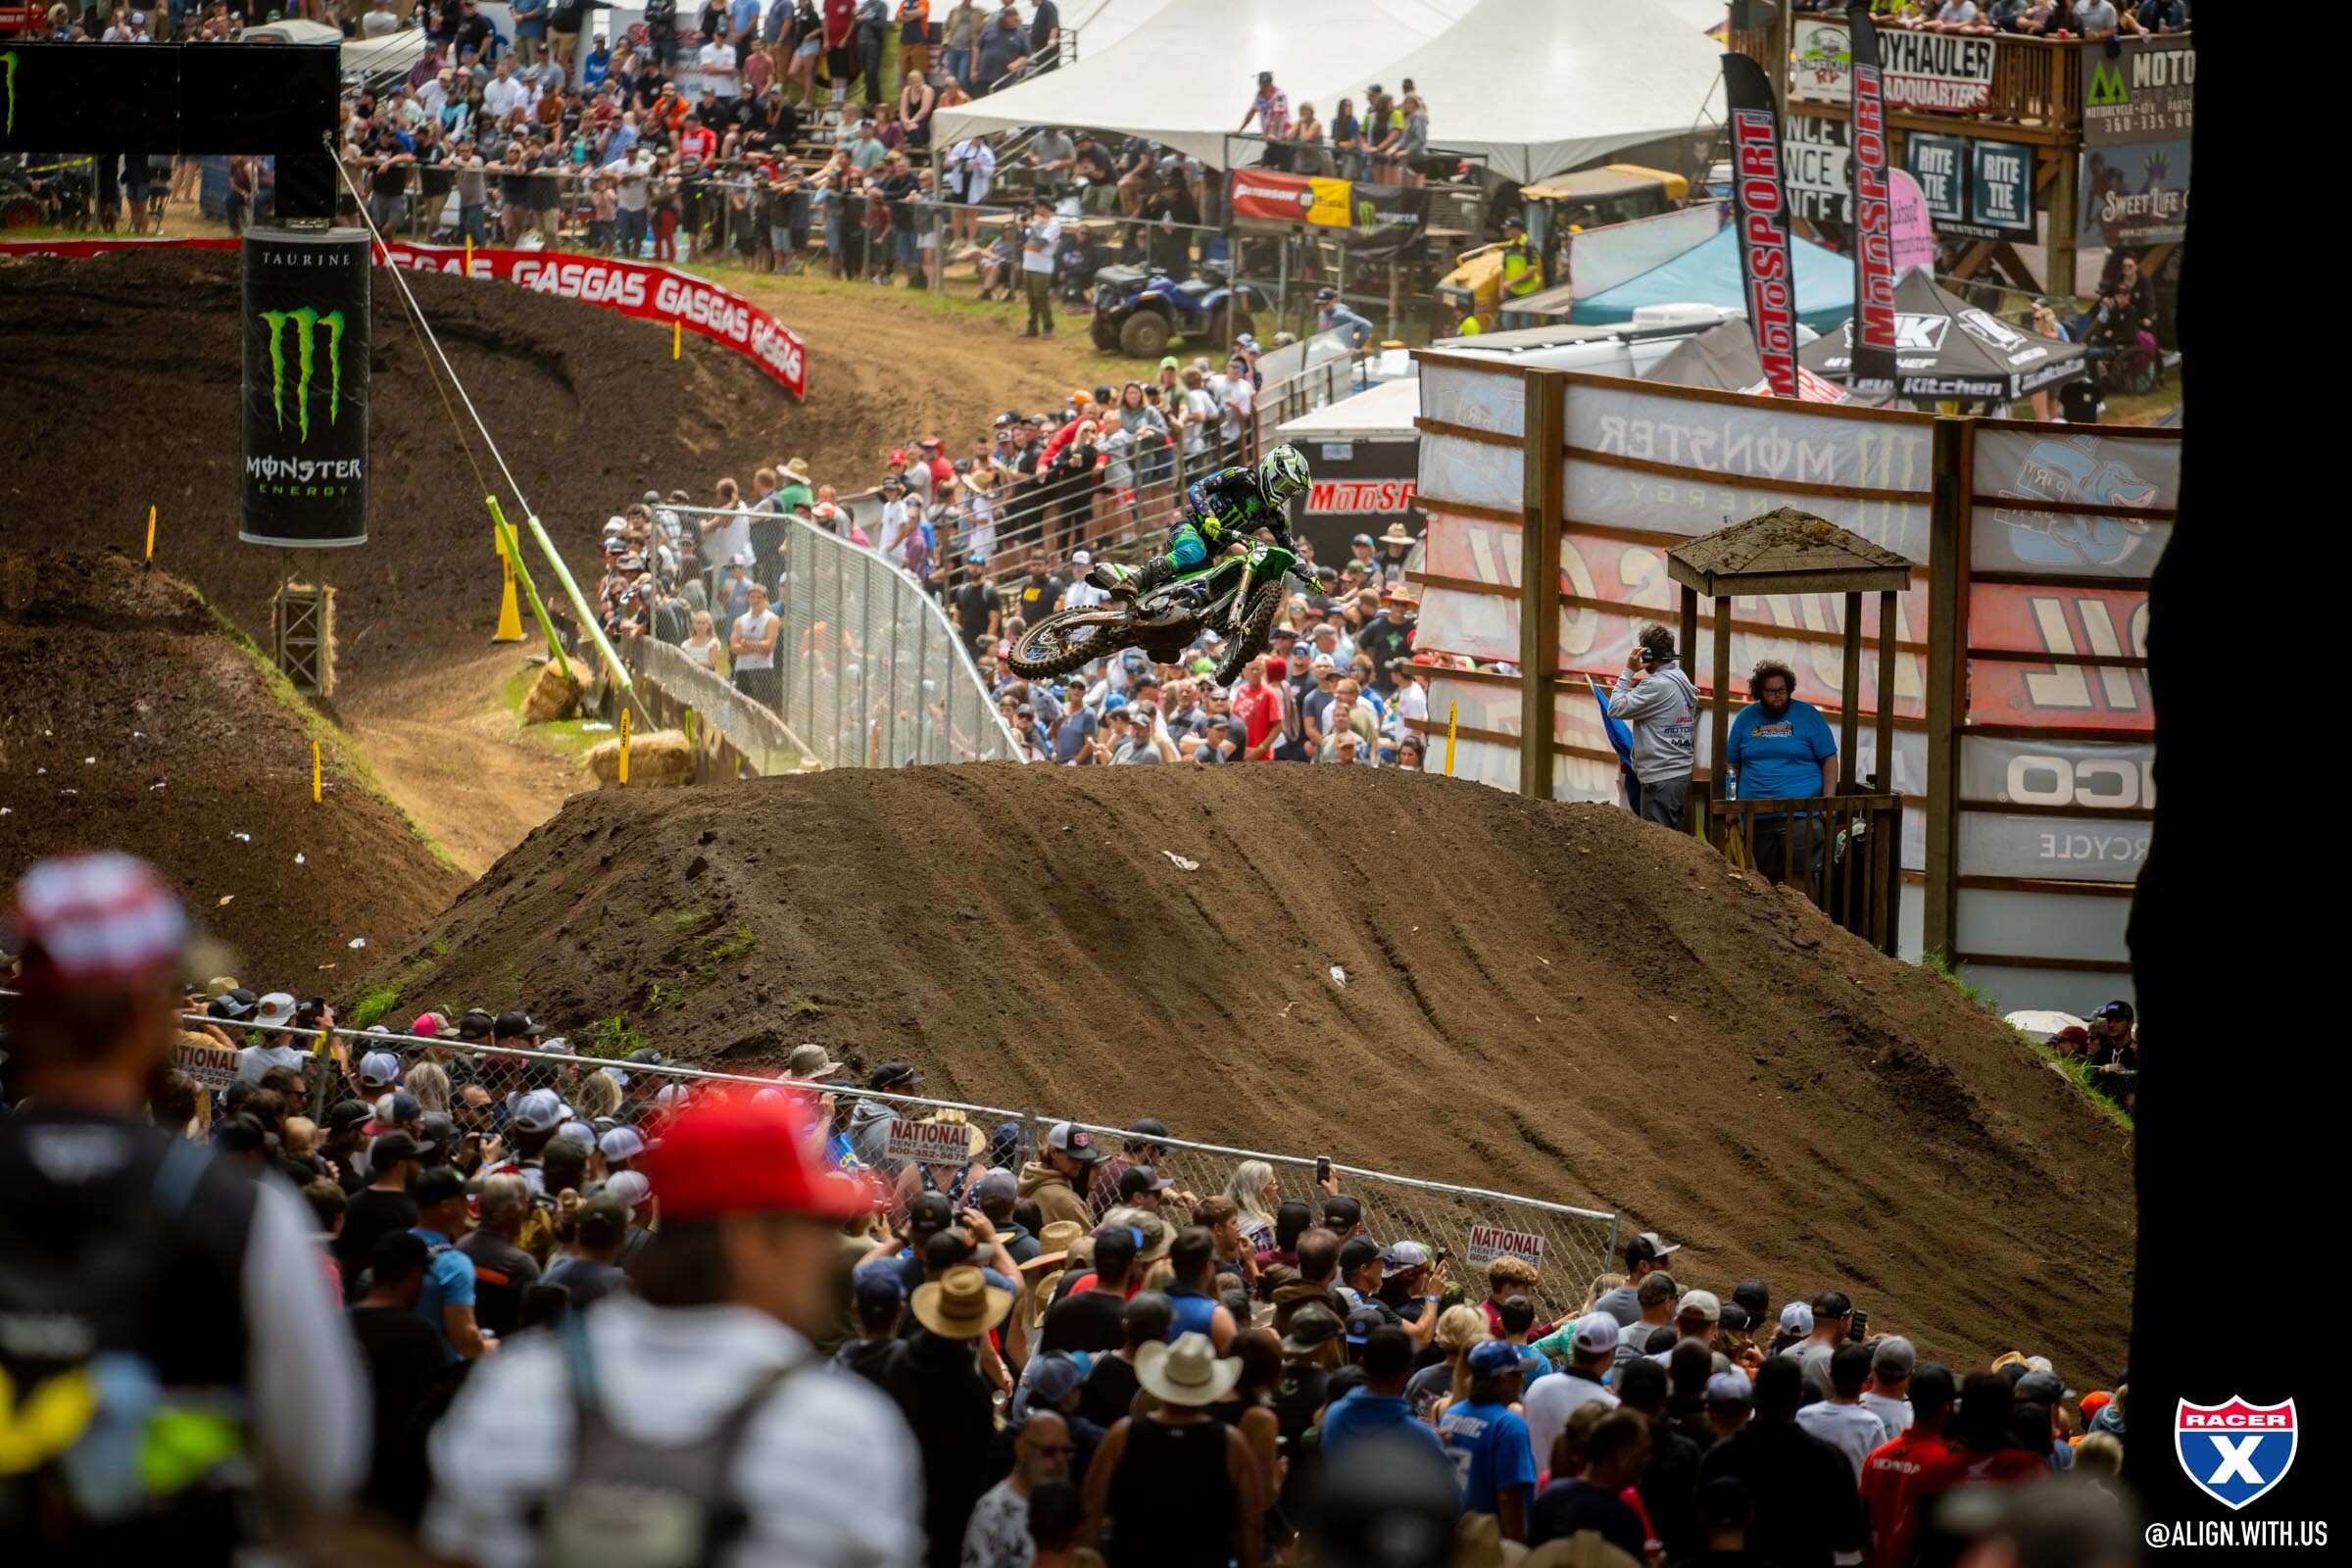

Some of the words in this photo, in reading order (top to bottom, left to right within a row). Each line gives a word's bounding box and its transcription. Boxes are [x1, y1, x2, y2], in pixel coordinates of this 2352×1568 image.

[2132, 51, 2195, 88] MOTO
[1918, 145, 1953, 174] RITE
[1983, 153, 2020, 183] RITE
[1922, 173, 1948, 201] TIE
[1987, 181, 2015, 210] TIE
[262, 251, 351, 267] TAURINE
[512, 261, 647, 307] GASGAS
[655, 278, 749, 344] GASGAS
[1902, 376, 2003, 397] Kitchen
[245, 454, 363, 483] MONSTER
[258, 483, 350, 498] ENERGY
[889, 1140, 968, 1153] RENT-A-FENCE
[890, 1120, 970, 1147] NATIONAL
[1472, 1226, 1541, 1256] NATIONAL
